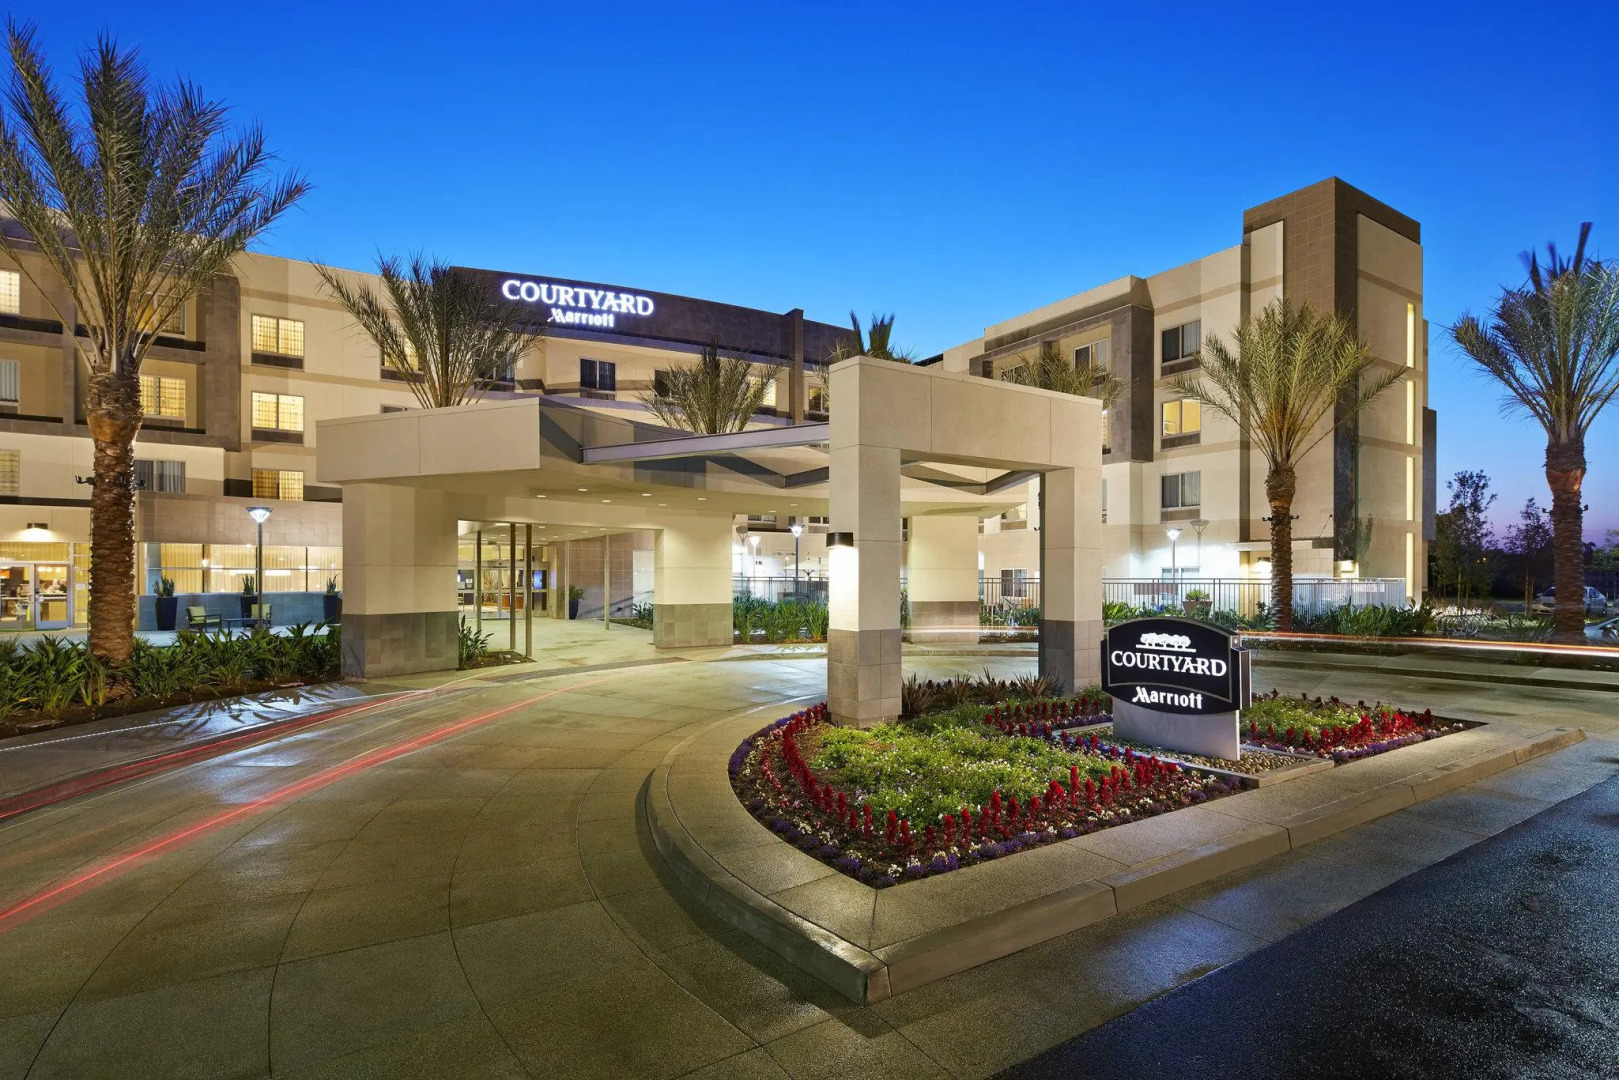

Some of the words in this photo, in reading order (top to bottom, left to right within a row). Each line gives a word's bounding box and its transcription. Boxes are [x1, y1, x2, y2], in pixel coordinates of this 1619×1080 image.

[502, 279, 655, 316] COURTYARD
[547, 307, 615, 327] Marriott
[1111, 650, 1227, 677] COURTYARD
[1132, 686, 1203, 709] Marriott
